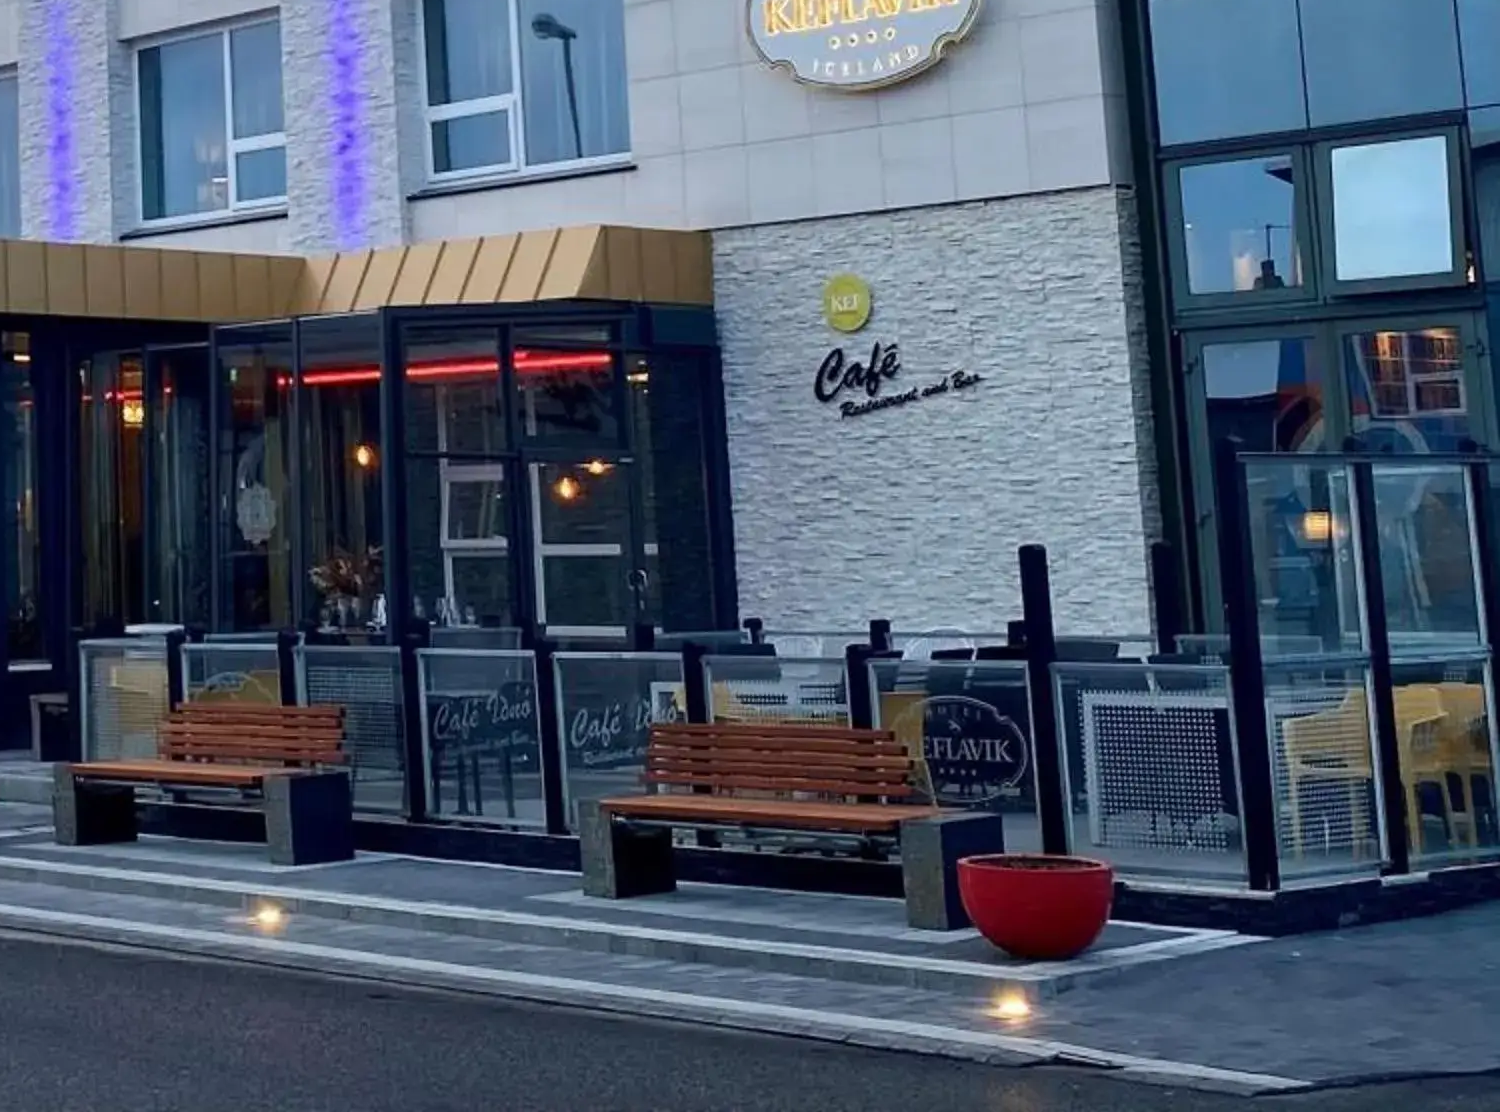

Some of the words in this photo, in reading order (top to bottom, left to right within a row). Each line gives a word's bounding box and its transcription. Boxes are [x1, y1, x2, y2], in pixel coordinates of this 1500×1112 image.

[813, 44, 919, 76] ICELAND
[814, 341, 900, 402] Café
[433, 698, 479, 740] Café
[571, 703, 622, 747] Café
